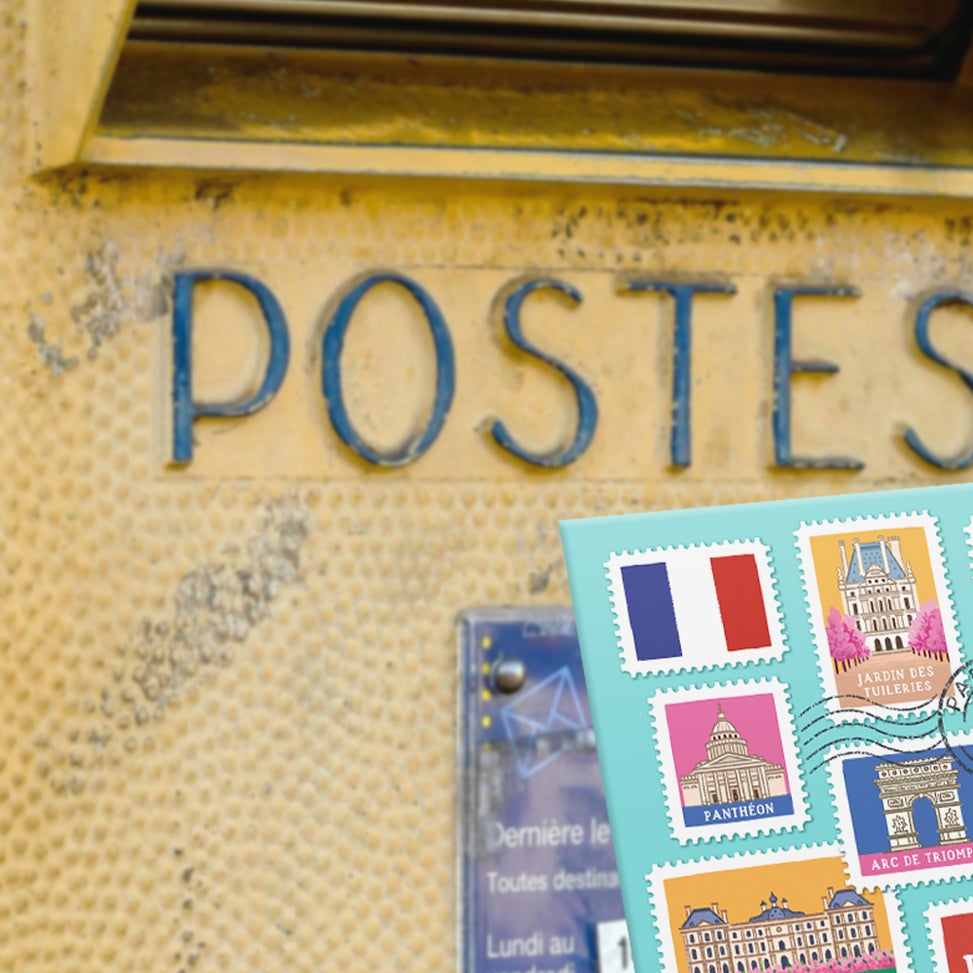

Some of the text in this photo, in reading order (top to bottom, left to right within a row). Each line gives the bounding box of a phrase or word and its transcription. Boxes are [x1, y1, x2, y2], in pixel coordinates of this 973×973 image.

[857, 666, 934, 687] JARDIN DES
[864, 680, 932, 698] TUILERIES
[704, 803, 775, 822] PANTHÉON
[488, 819, 584, 848] Dernière
[871, 855, 899, 871] ARC
[904, 852, 920, 867] DE
[486, 871, 549, 894] Toutes
[486, 932, 575, 959] Lundi au
